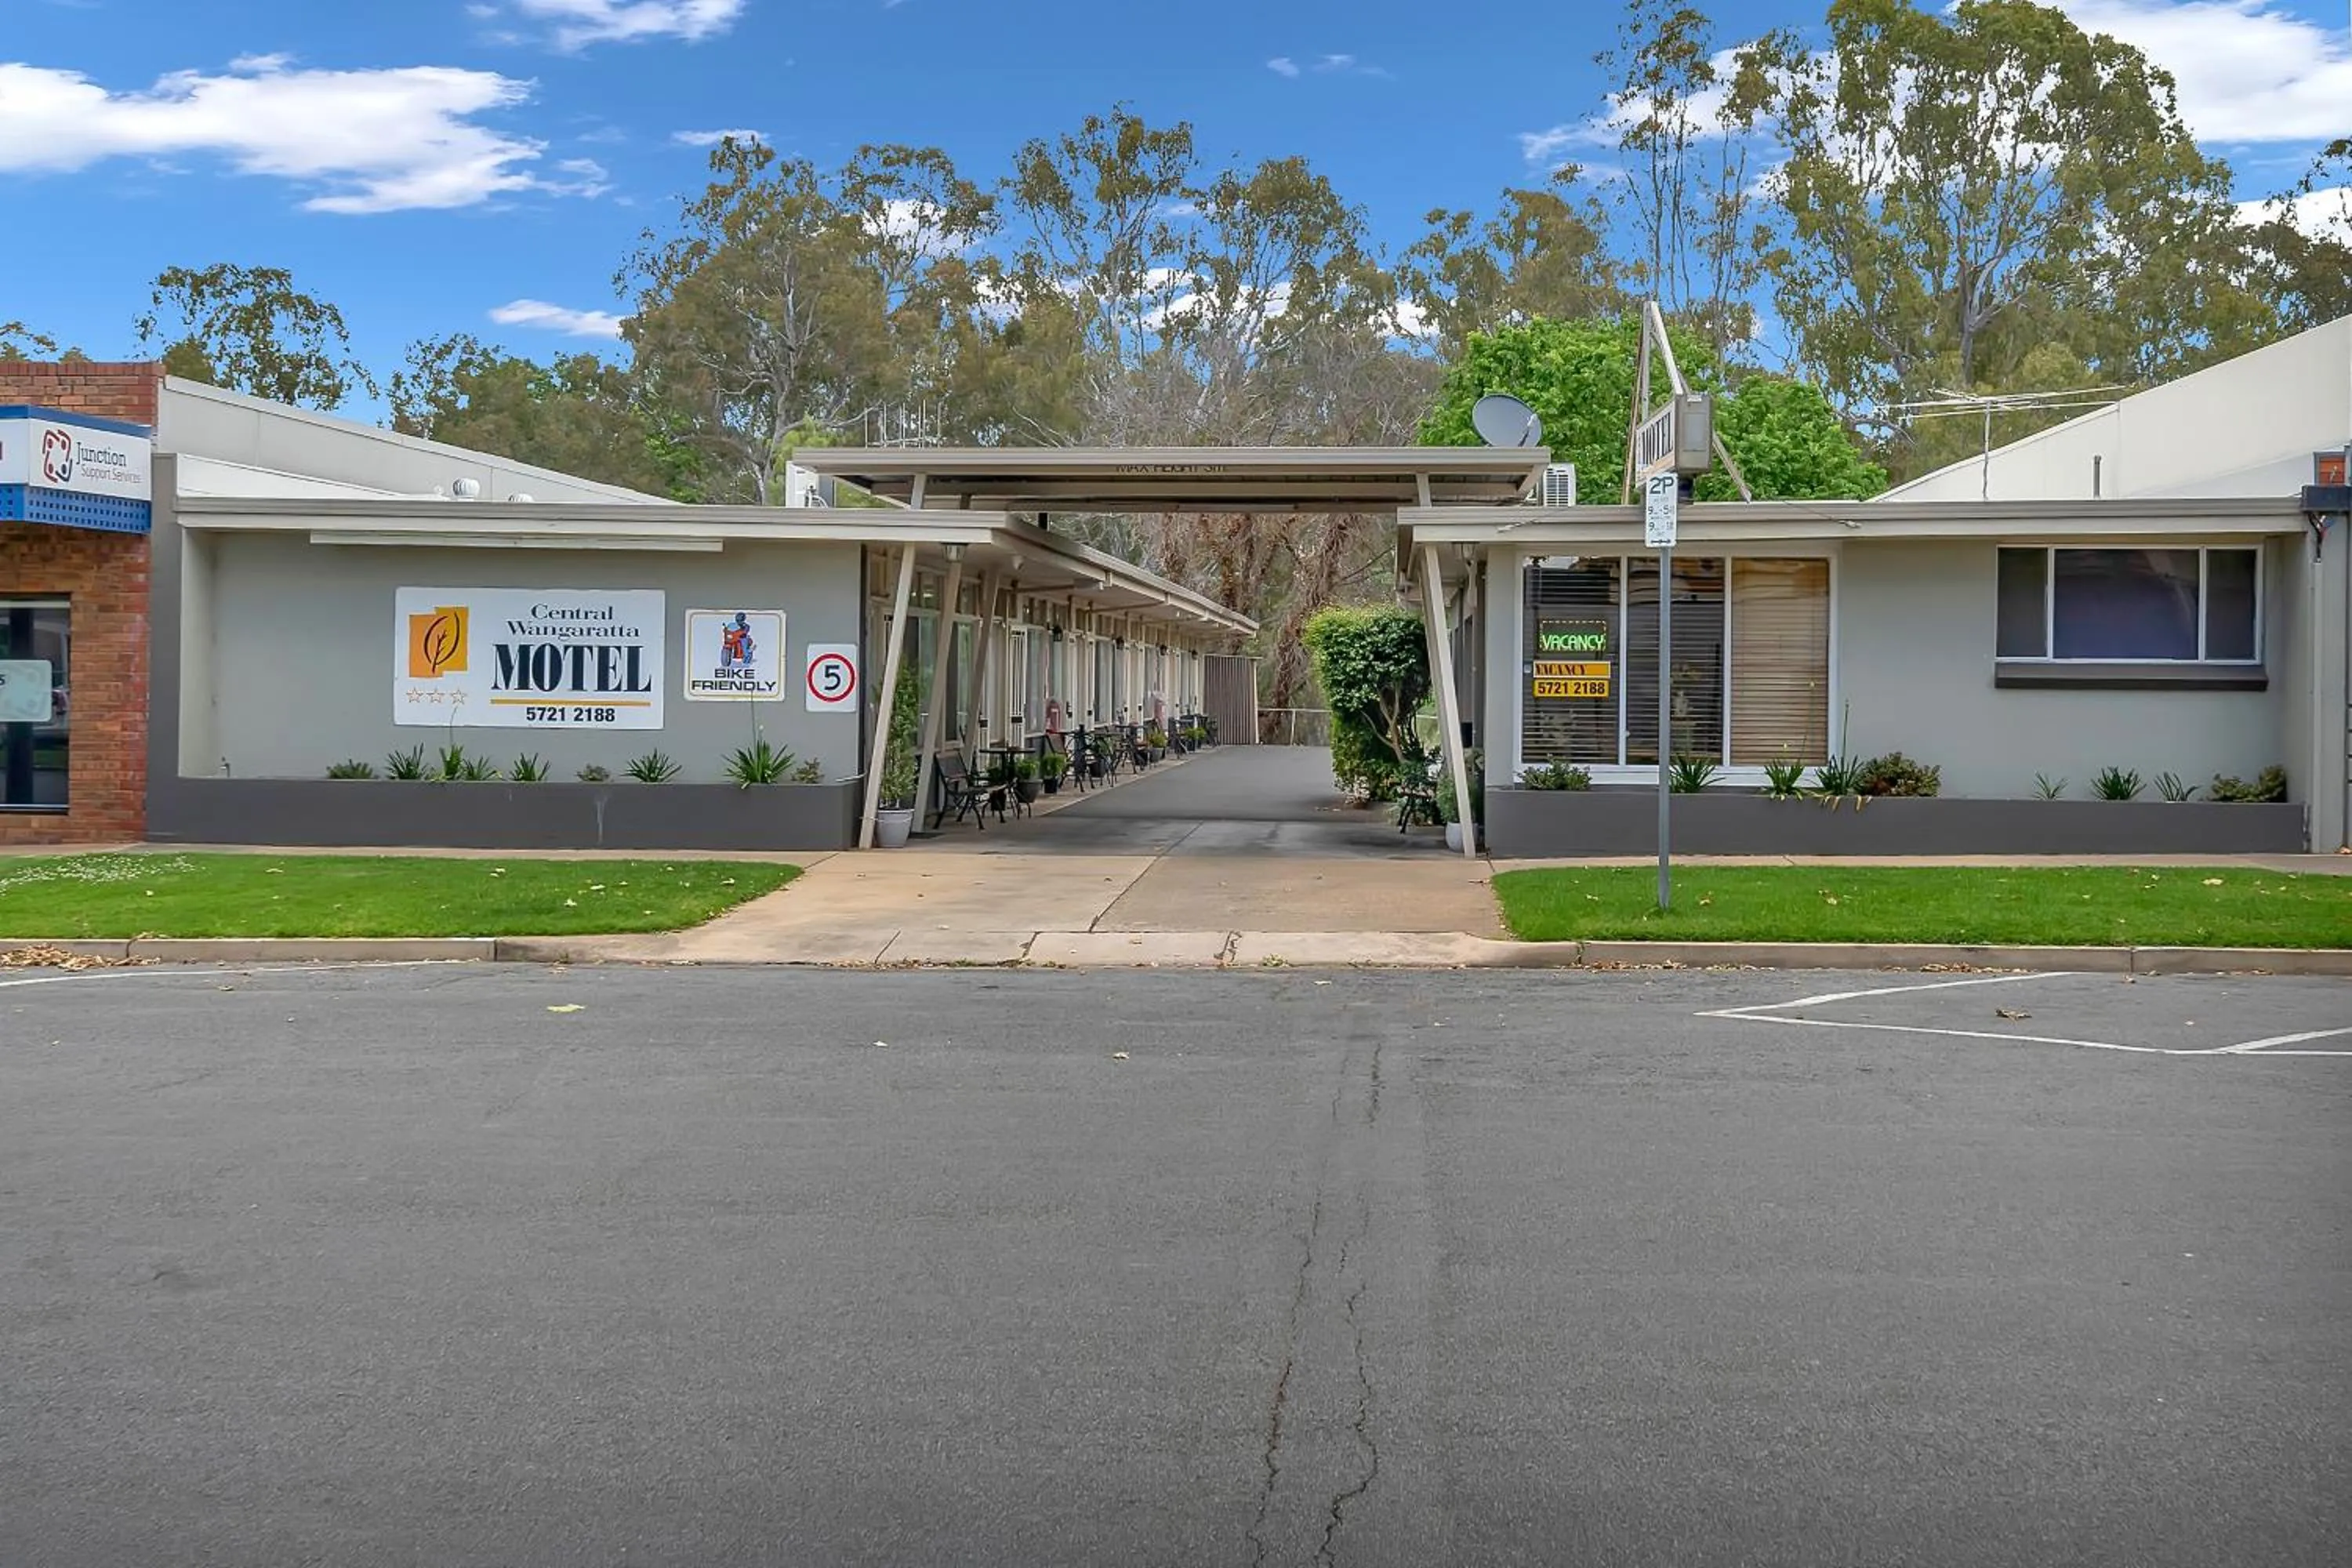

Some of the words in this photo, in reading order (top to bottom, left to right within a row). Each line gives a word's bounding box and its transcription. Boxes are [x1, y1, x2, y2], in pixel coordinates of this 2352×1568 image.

[1638, 412, 1674, 466] MOTEL
[76, 441, 126, 466] Junction
[81, 464, 111, 481] Support
[1649, 476, 1675, 495] 2P
[531, 603, 614, 621] Central
[506, 620, 640, 641] Wangaratta
[1541, 634, 1605, 652] VACANCY
[491, 642, 652, 692] MOTEL
[714, 669, 755, 679] BIKE
[691, 680, 777, 691] FRIENDLY
[824, 665, 841, 691] 5
[1537, 681, 1568, 695] 5721
[1573, 681, 1605, 695] 2188
[526, 706, 565, 722] 5721
[573, 707, 615, 722] 2188
